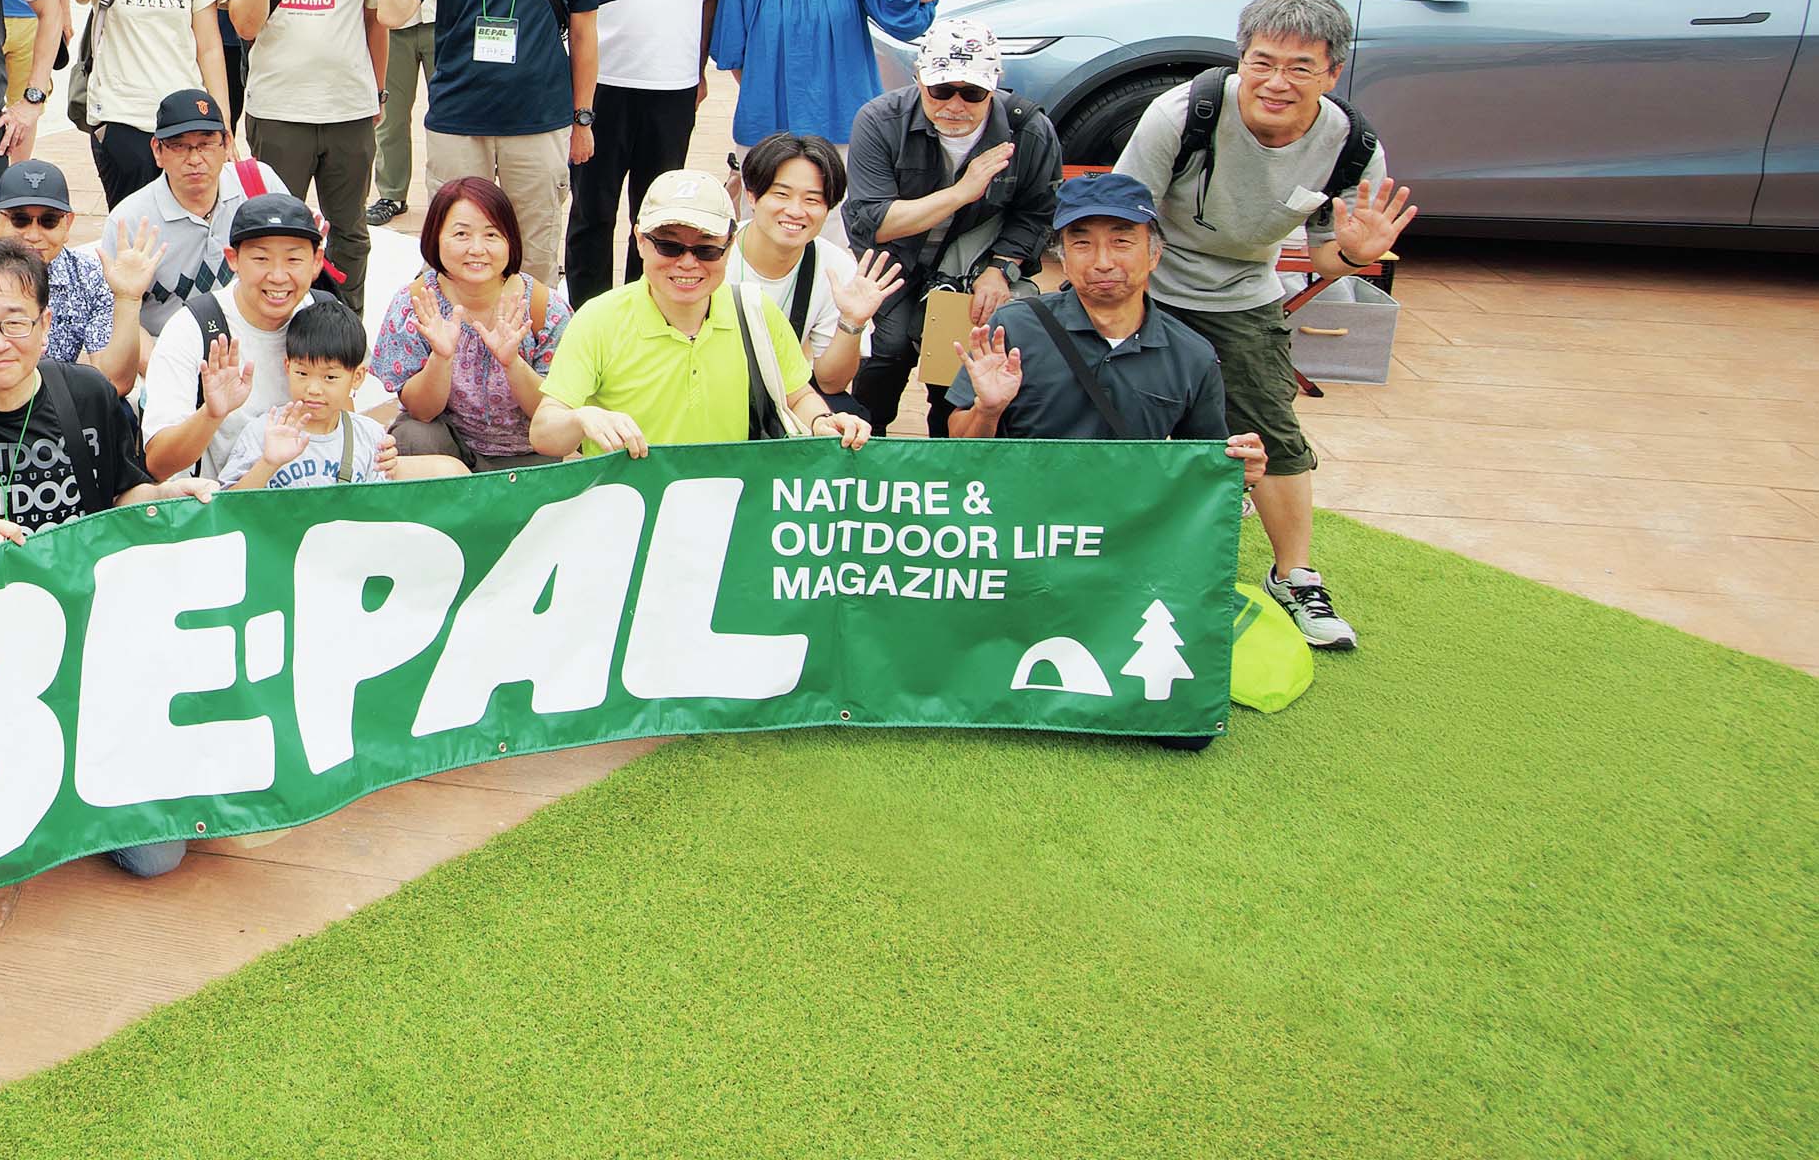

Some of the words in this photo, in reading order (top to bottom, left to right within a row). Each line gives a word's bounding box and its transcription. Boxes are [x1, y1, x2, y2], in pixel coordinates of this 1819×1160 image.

[772, 478, 950, 515] NATURE
[962, 481, 993, 515] &
[771, 520, 999, 559] OUTDOOR
[1014, 525, 1105, 559] LIFE
[772, 562, 1009, 600] MAGAZINE
